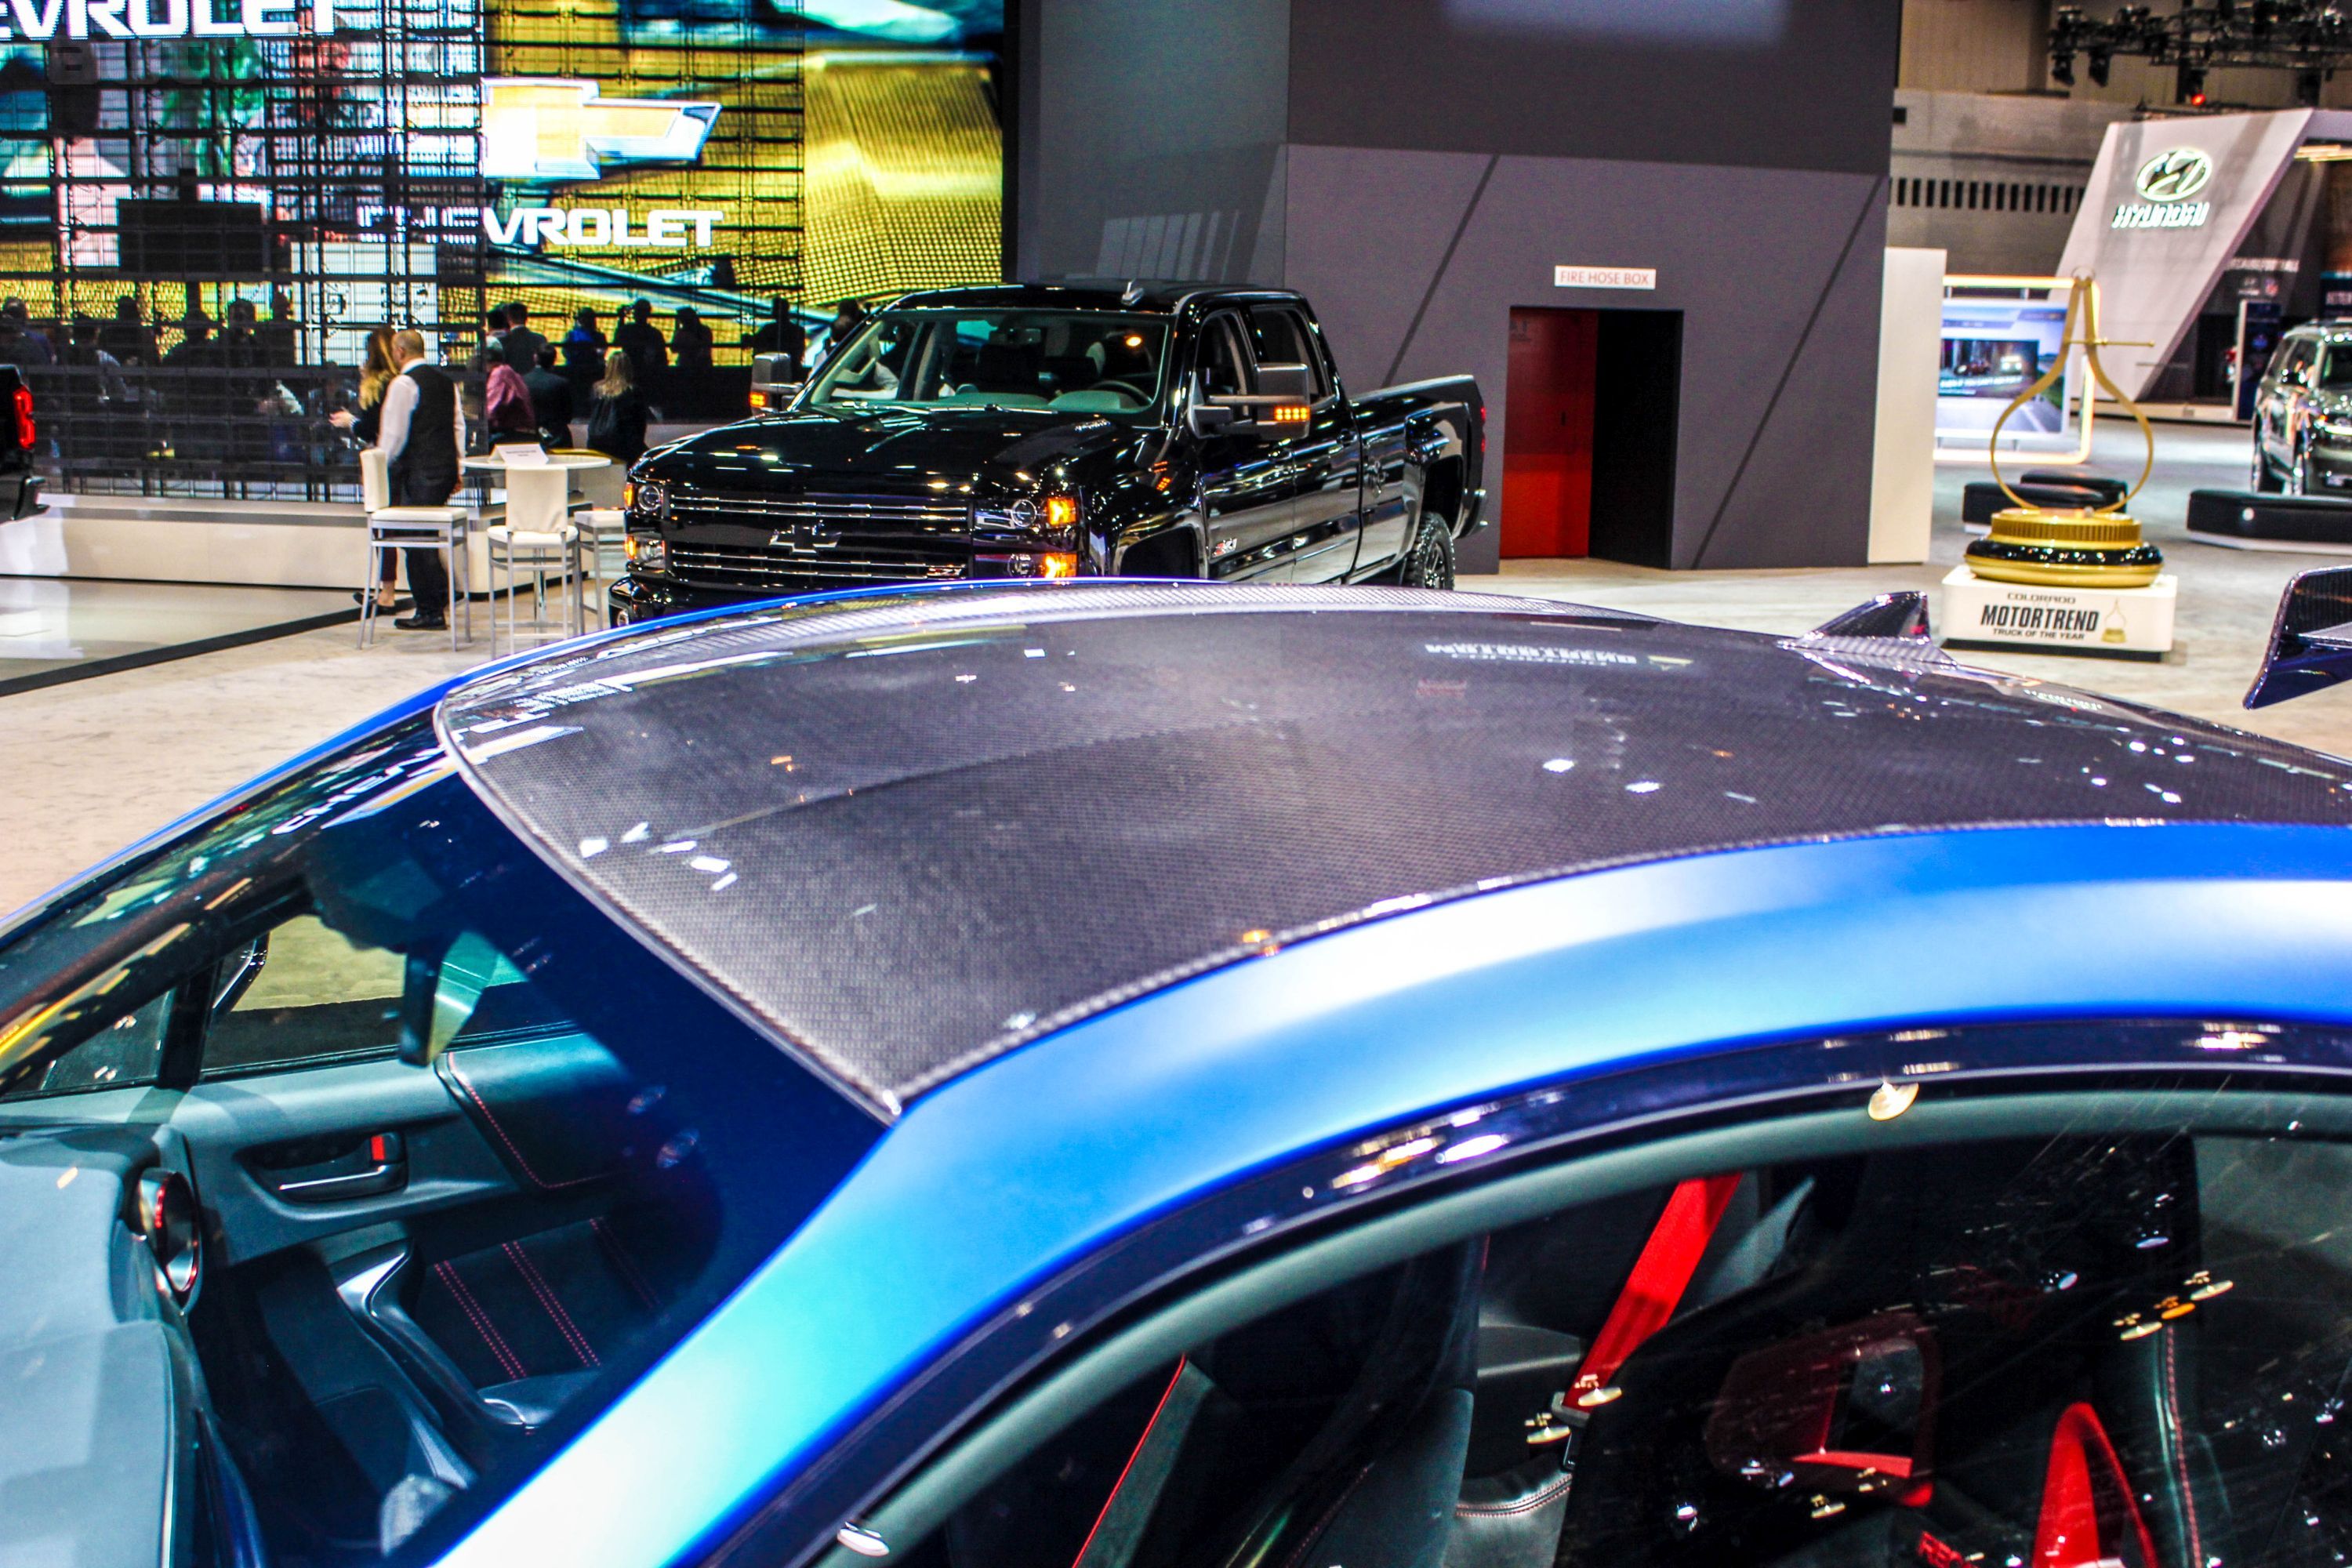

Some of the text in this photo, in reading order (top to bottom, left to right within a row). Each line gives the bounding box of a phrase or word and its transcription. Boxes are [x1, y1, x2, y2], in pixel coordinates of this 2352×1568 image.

[1560, 270, 1650, 285] FIRE HOSE BOX
[2007, 592, 2076, 604] COLORADO
[1980, 604, 2100, 632] MOTORTREND
[1993, 627, 2023, 637] TRUCK
[2040, 630, 2058, 639] THE
[2060, 631, 2085, 640] YEAR
